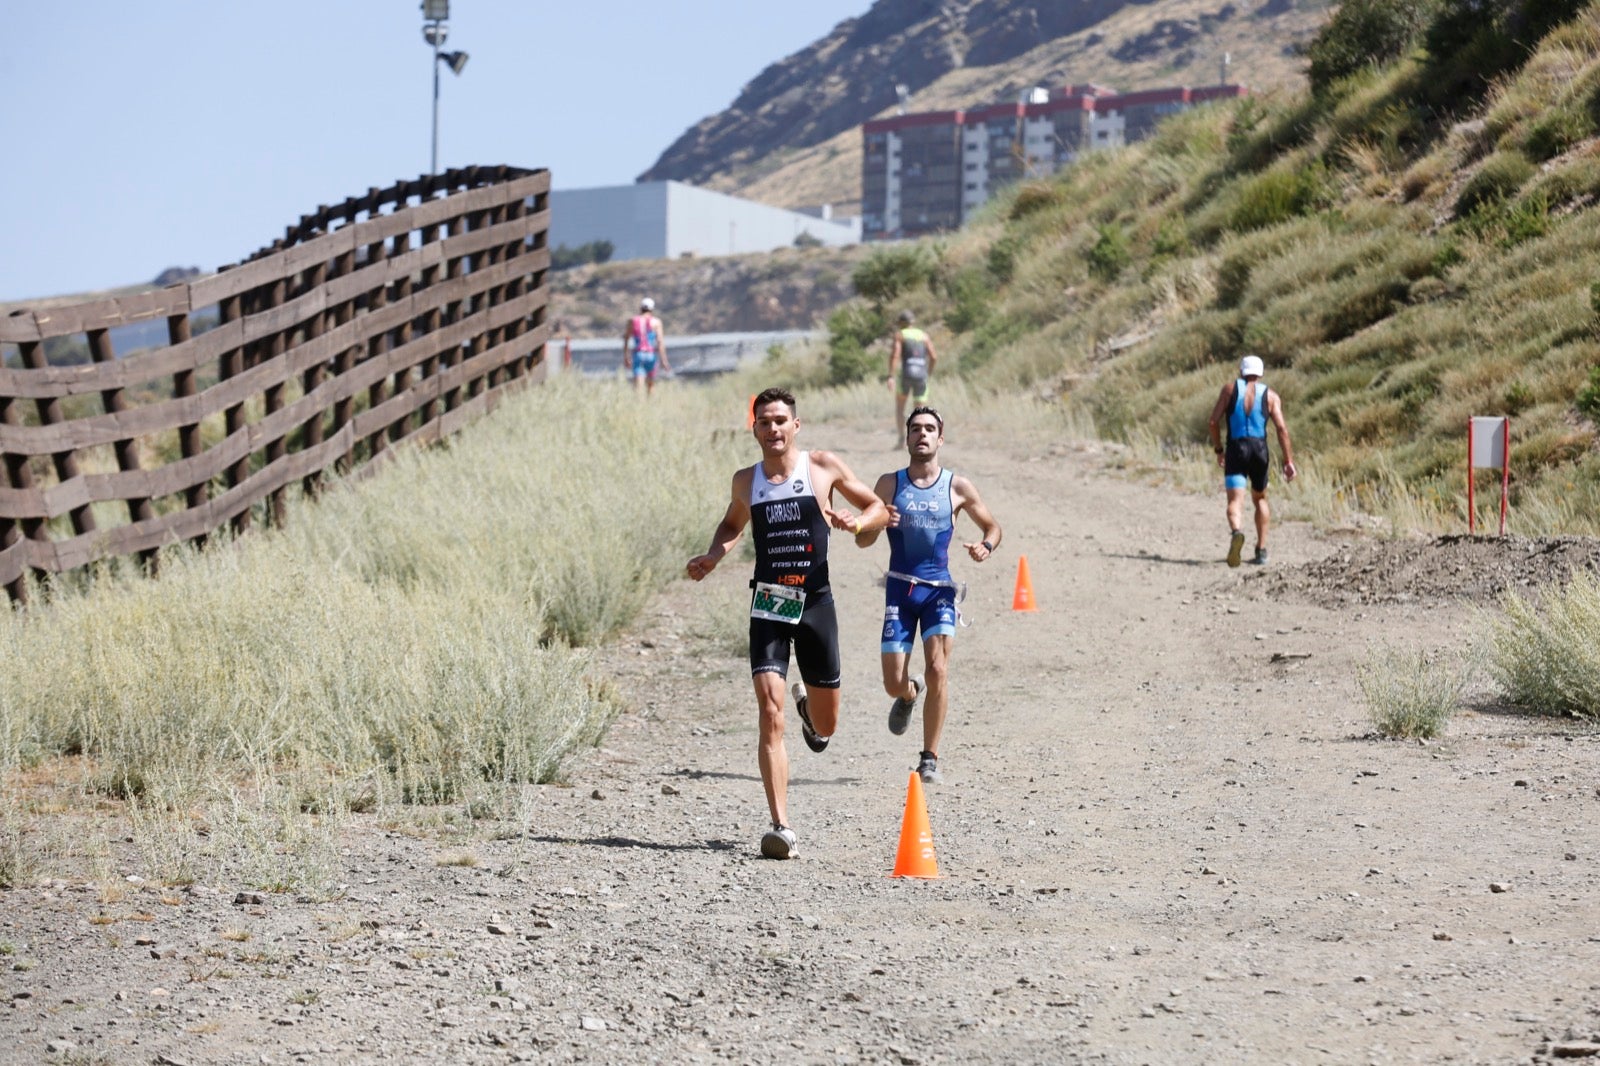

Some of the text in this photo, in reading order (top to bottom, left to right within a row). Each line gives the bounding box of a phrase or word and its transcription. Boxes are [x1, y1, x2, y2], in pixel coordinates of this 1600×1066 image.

[905, 500, 939, 511] ADS
[766, 501, 801, 524] CARRASCO
[767, 545, 805, 554] LASERGRAN
[771, 560, 811, 568] FASTER
[777, 574, 806, 585] HSN
[772, 597, 785, 613] 7
